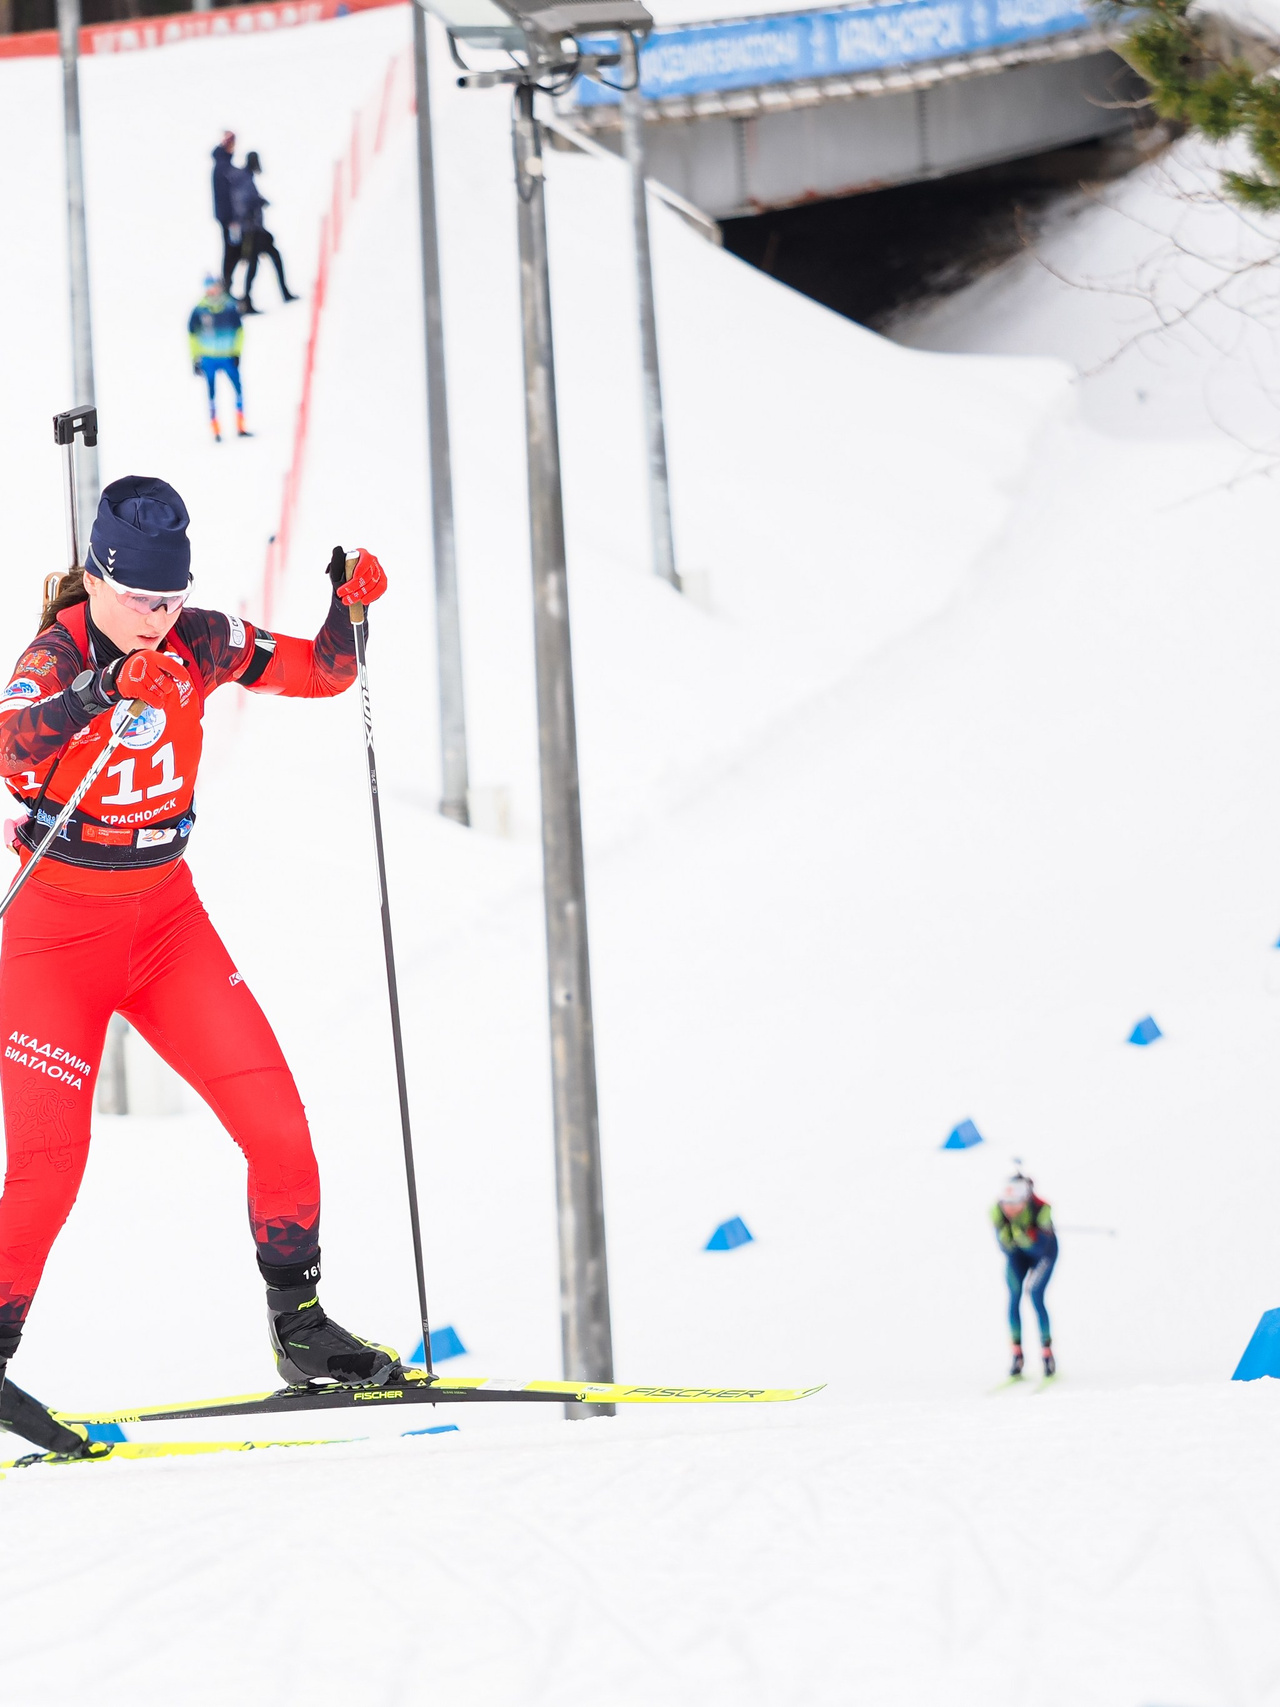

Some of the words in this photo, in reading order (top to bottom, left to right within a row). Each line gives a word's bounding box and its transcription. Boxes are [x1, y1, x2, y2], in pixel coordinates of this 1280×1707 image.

[101, 742, 183, 805] 11
[4, 1045, 83, 1091] БИАТЛОНА
[8, 1030, 91, 1077] АКАДЕМИЯ
[353, 1390, 403, 1401] FISCHER
[623, 1387, 765, 1398] FISCHER
